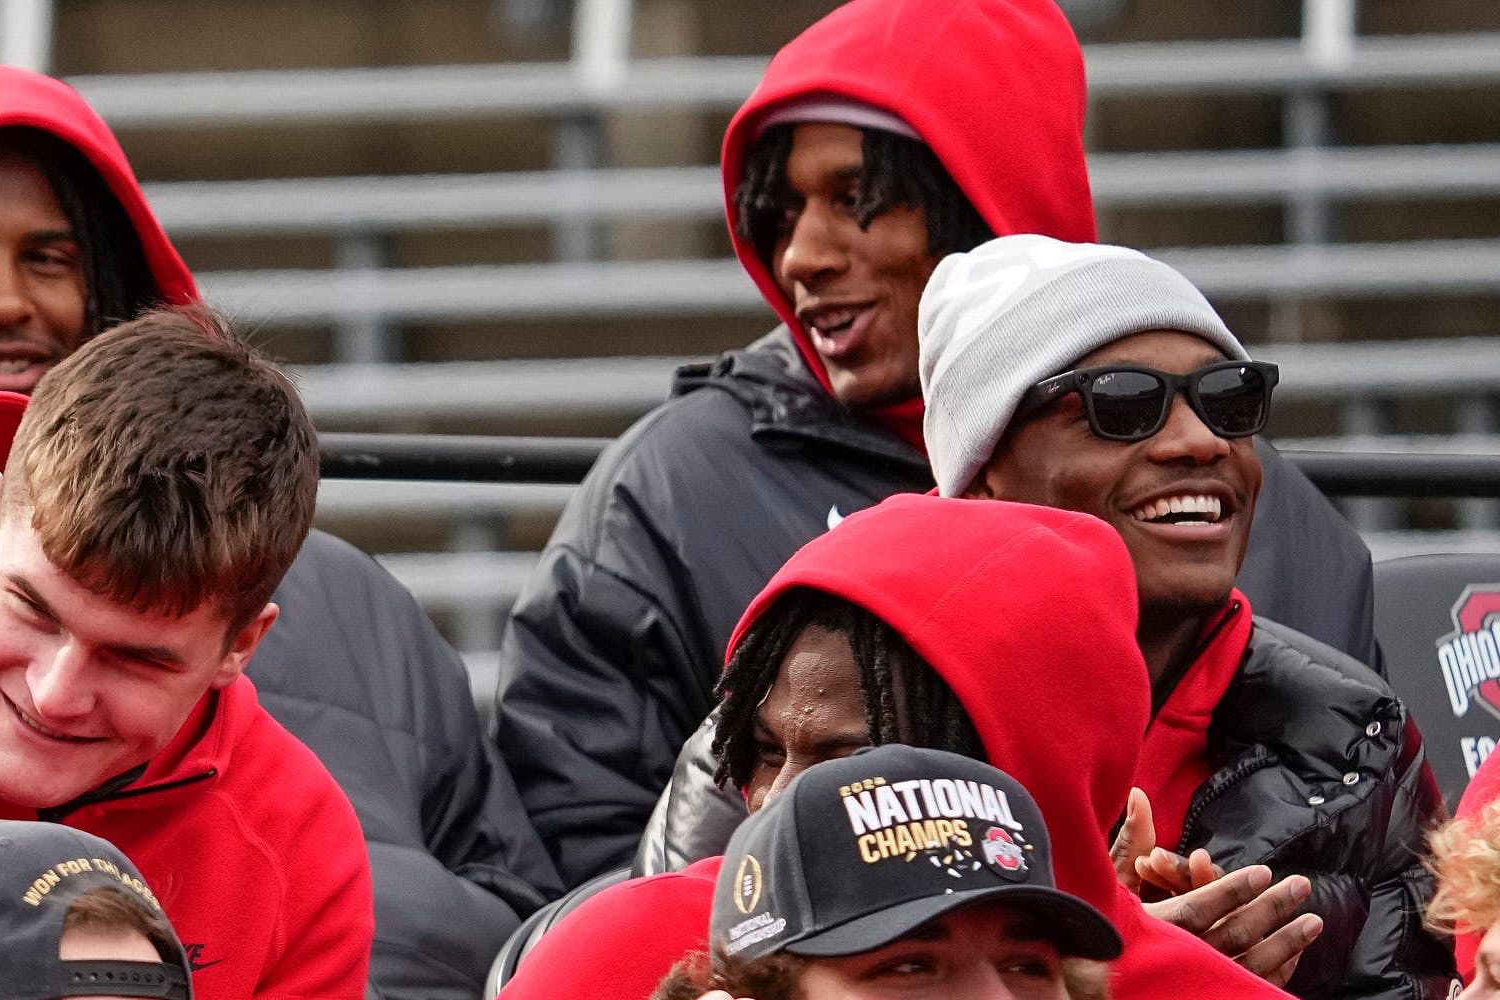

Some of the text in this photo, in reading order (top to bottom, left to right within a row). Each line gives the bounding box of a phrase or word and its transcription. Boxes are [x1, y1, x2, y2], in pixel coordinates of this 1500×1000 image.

[842, 778, 1023, 836] NATIONAL
[857, 819, 973, 864] CHAMPS
[22, 868, 62, 907] WON
[55, 857, 94, 878] FOR
